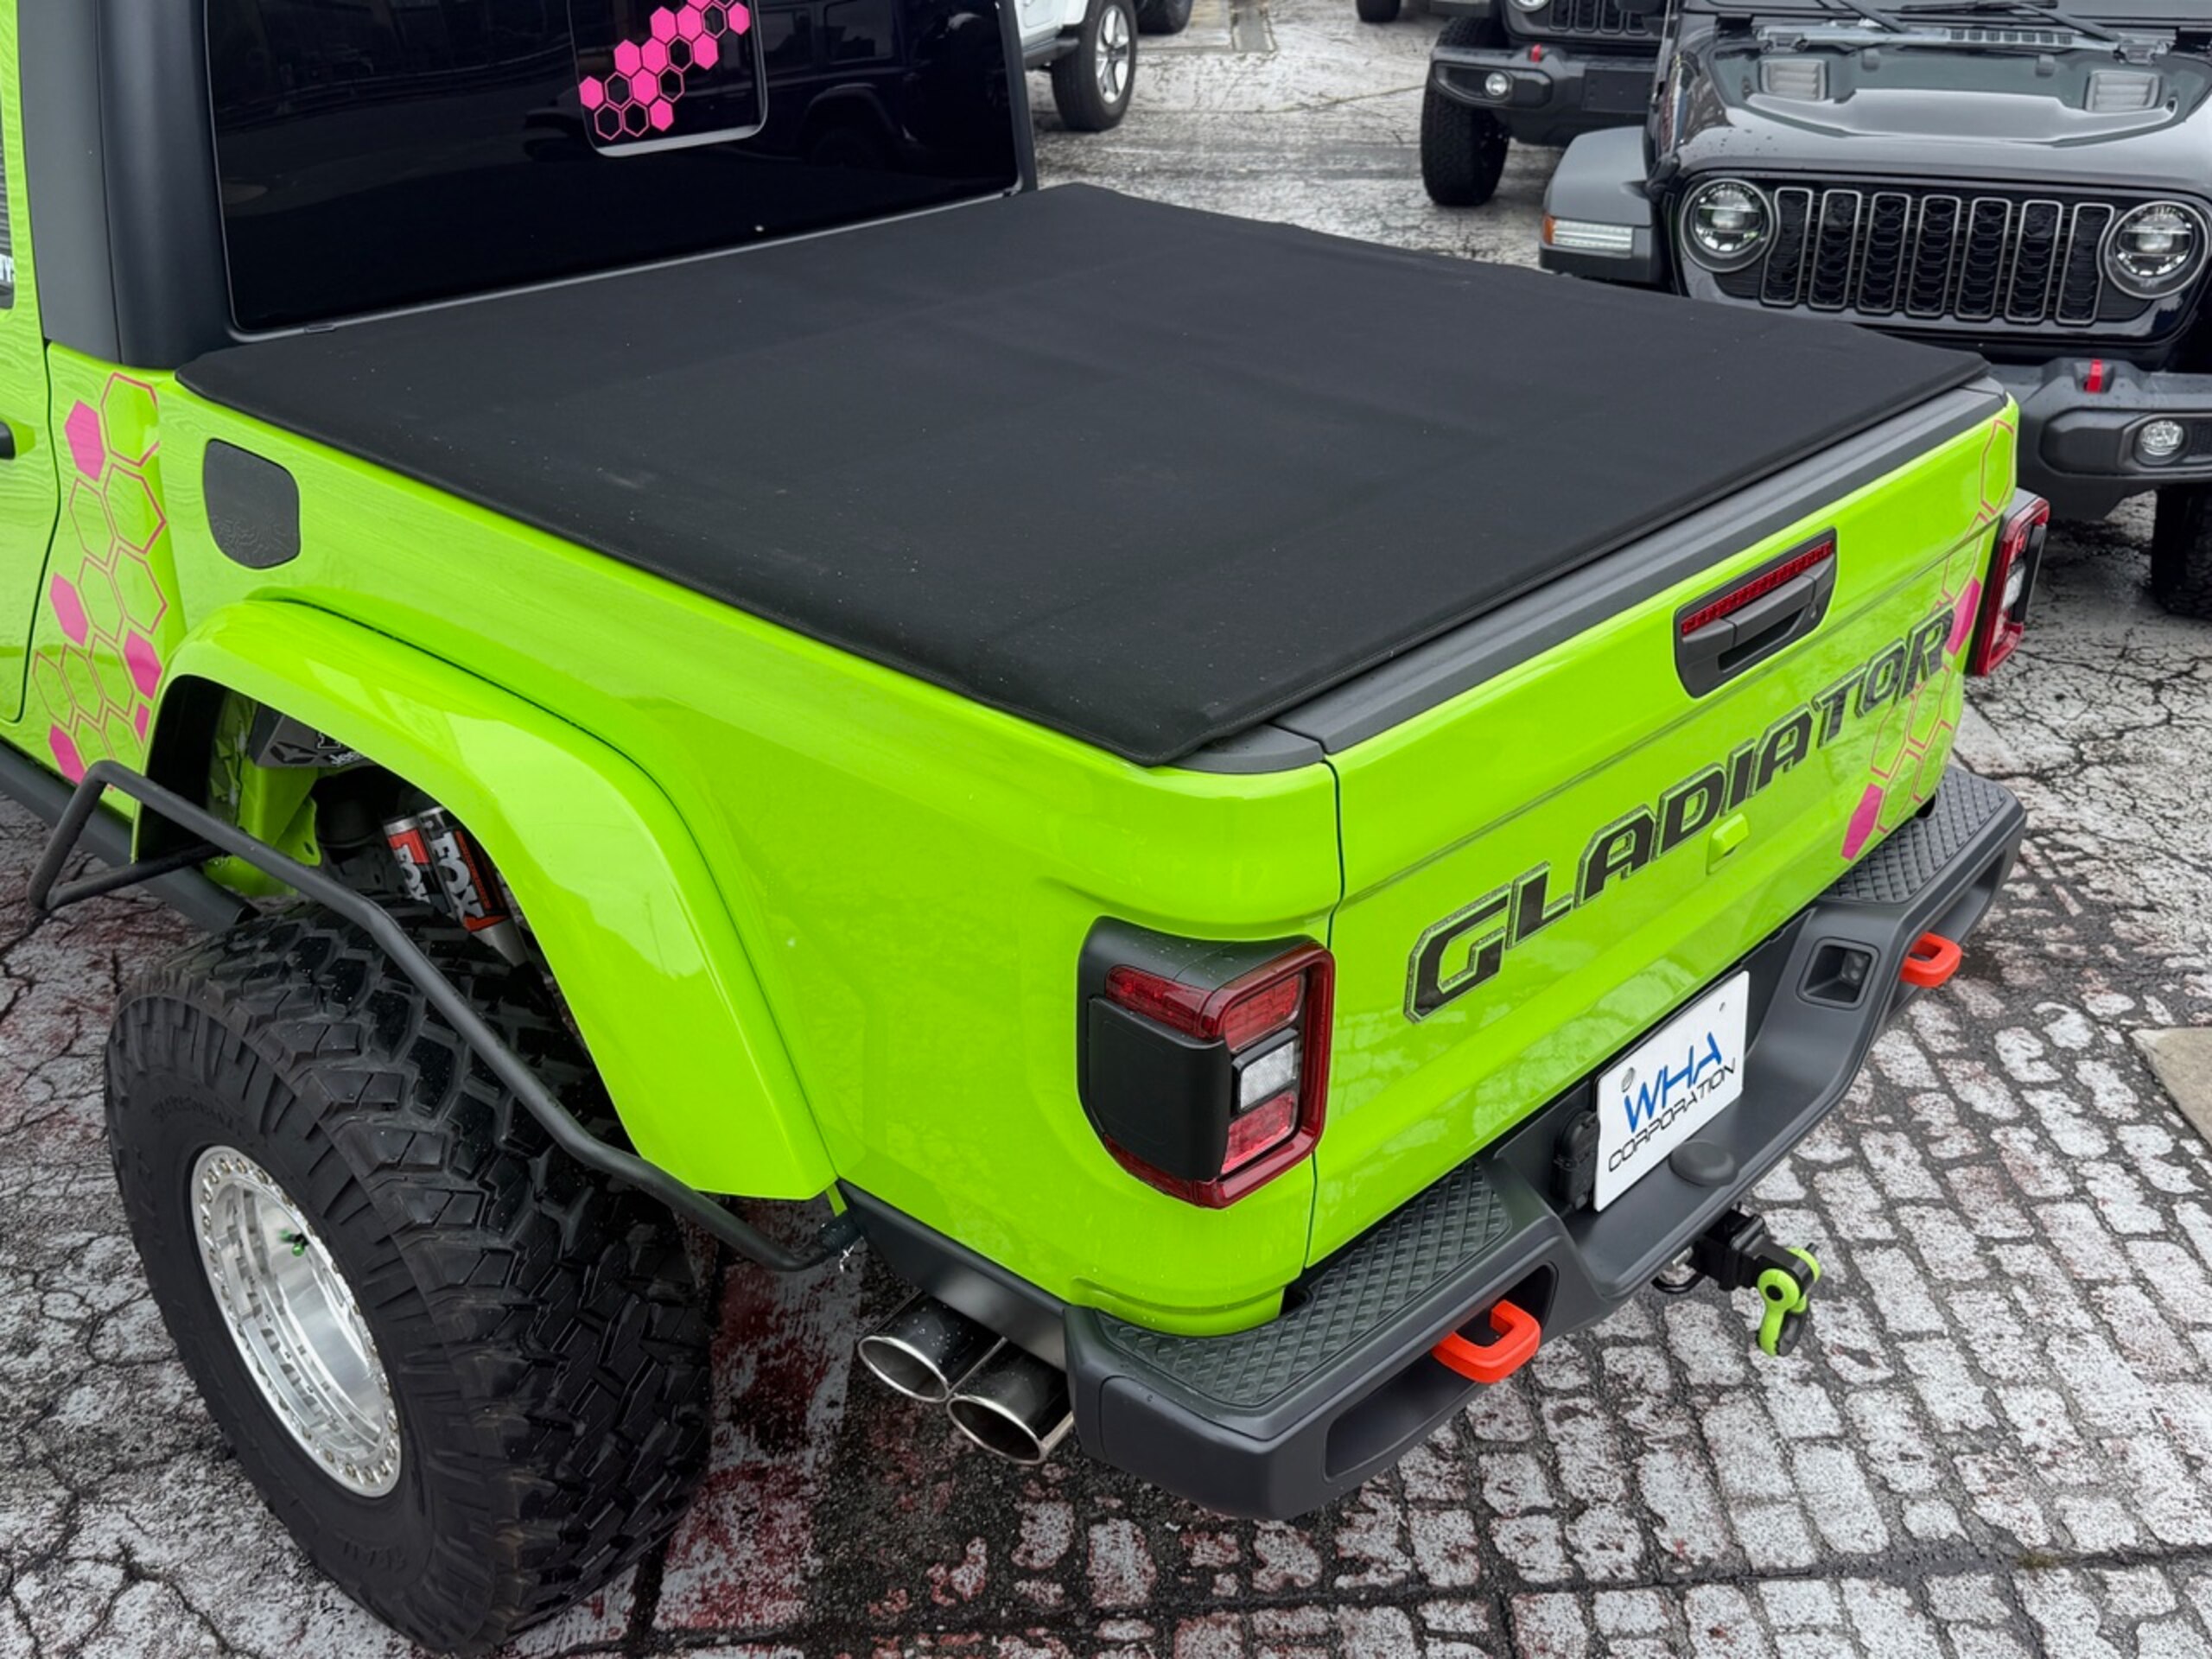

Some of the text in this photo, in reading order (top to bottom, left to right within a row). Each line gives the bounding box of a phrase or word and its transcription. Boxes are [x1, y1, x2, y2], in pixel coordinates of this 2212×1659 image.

[1404, 607, 1955, 1024] GLADIATOR
[430, 831, 485, 925] FOX
[1608, 1057, 1736, 1173] CORPORATION
